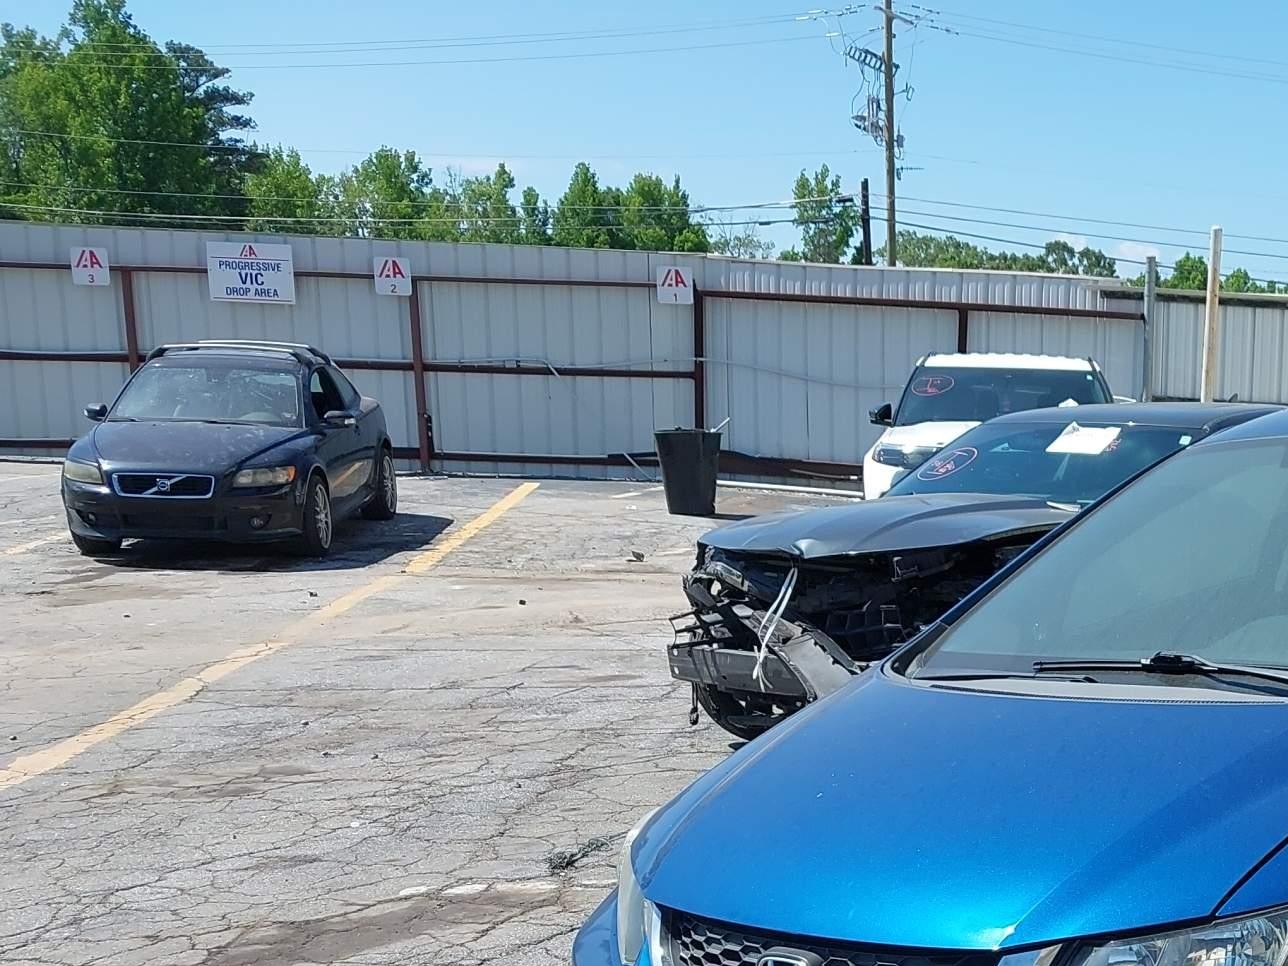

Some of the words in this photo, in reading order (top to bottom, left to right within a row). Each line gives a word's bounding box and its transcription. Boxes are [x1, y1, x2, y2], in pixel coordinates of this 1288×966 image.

[218, 260, 282, 272] PROGRESSIVE
[87, 273, 96, 284] 3
[238, 271, 265, 286] VIC
[225, 286, 251, 297] DROP
[254, 287, 279, 299] AREA
[390, 283, 398, 294] 2
[673, 292, 678, 302] 1
